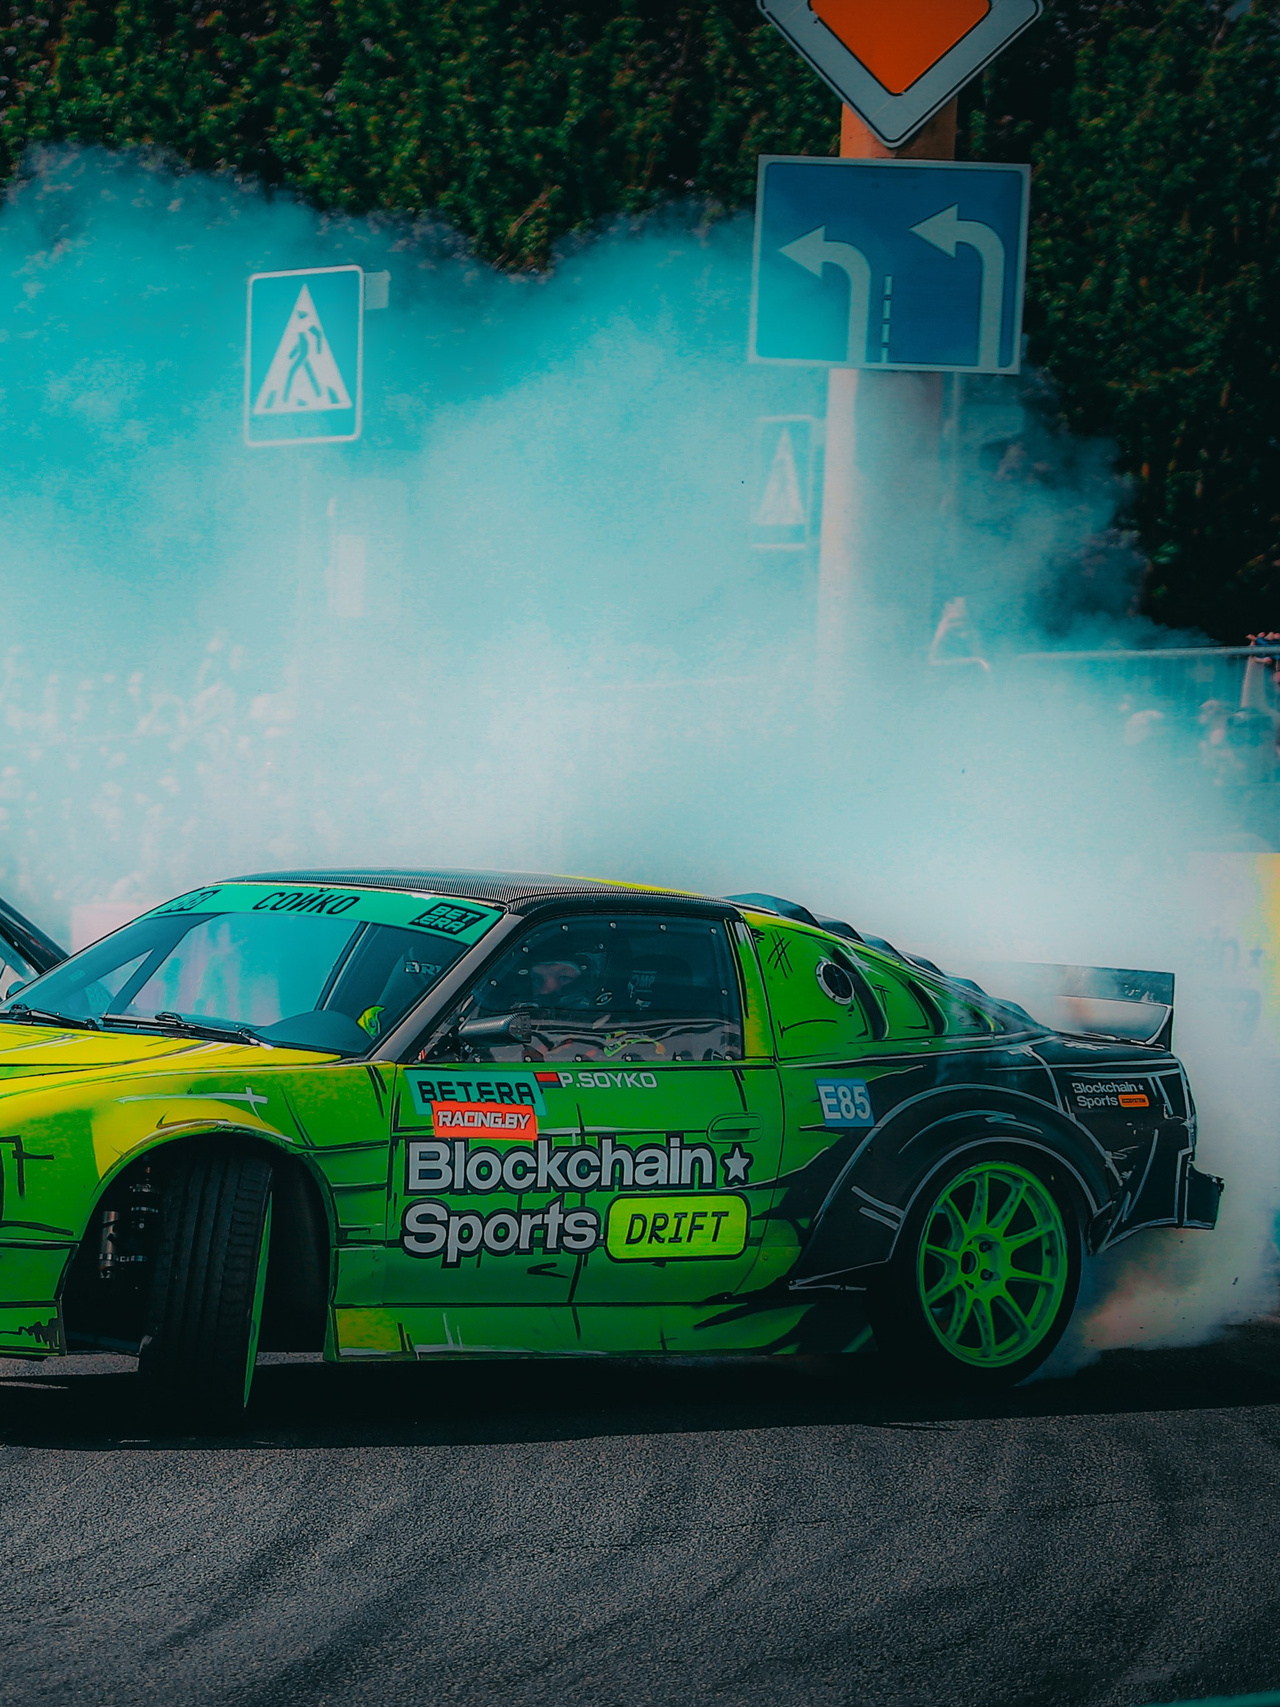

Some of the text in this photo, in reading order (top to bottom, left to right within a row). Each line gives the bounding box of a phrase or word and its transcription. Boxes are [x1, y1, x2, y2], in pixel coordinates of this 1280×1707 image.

[252, 887, 360, 914] СОЙКО
[431, 906, 480, 923] BET
[559, 1072, 658, 1089] P.SOYKO
[1071, 1082, 1138, 1094] Blockchain
[819, 1085, 872, 1121] E85
[1077, 1095, 1119, 1109] Sports
[437, 1111, 531, 1130] RACING.BY
[408, 1137, 714, 1190] Blockchain
[403, 1200, 597, 1264] Sports
[624, 1211, 729, 1245] DRIFT
